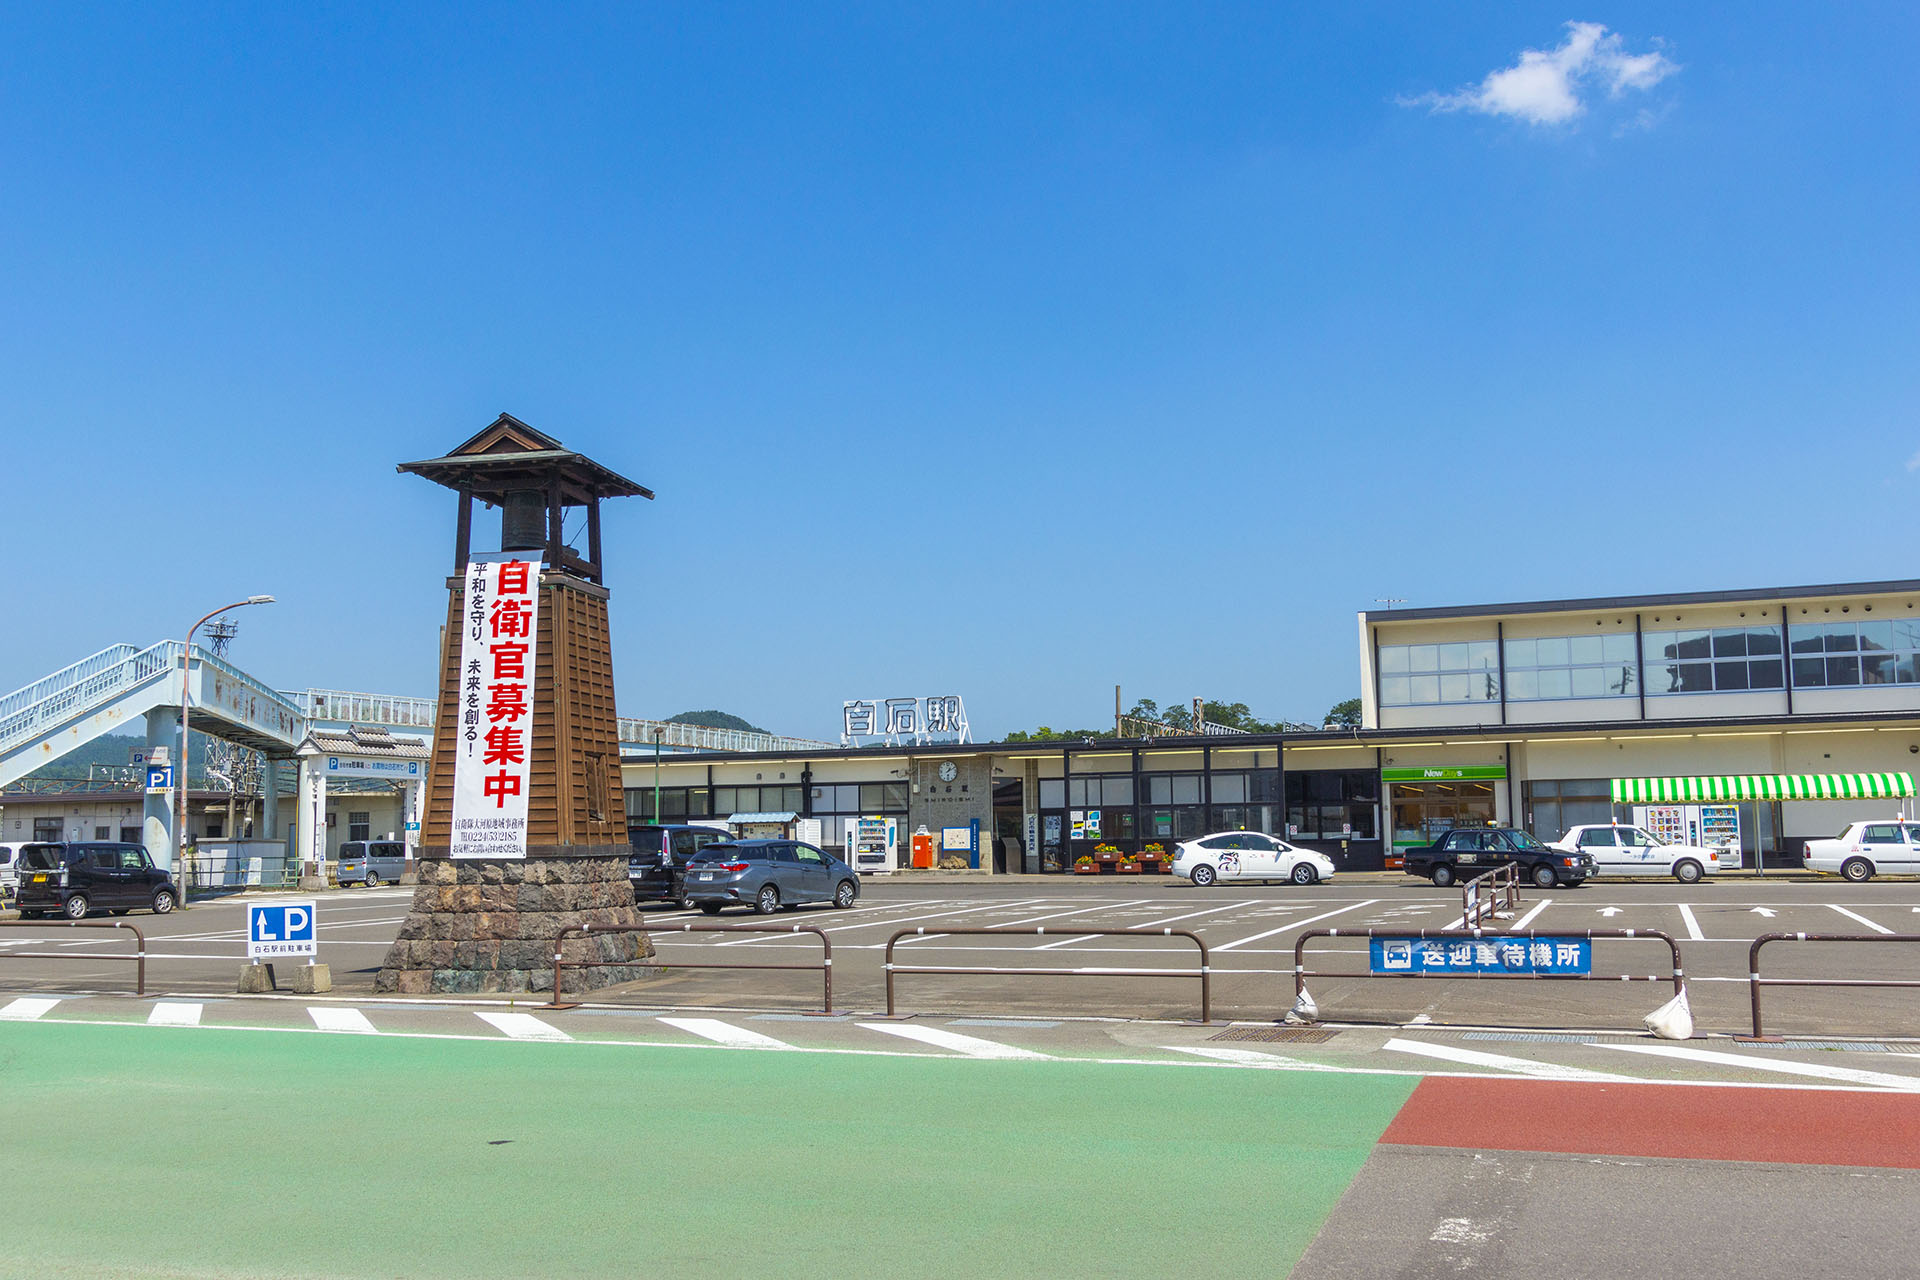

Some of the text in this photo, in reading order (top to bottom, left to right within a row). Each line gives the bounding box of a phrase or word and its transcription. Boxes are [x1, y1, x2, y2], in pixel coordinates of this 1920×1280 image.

[483, 559, 532, 808] 自衛官募集中
[844, 696, 960, 736] 白石駅
[284, 908, 309, 940] P
[255, 944, 312, 953] 白石駅前駐車場
[1422, 943, 1581, 967] 送迎車待機所
